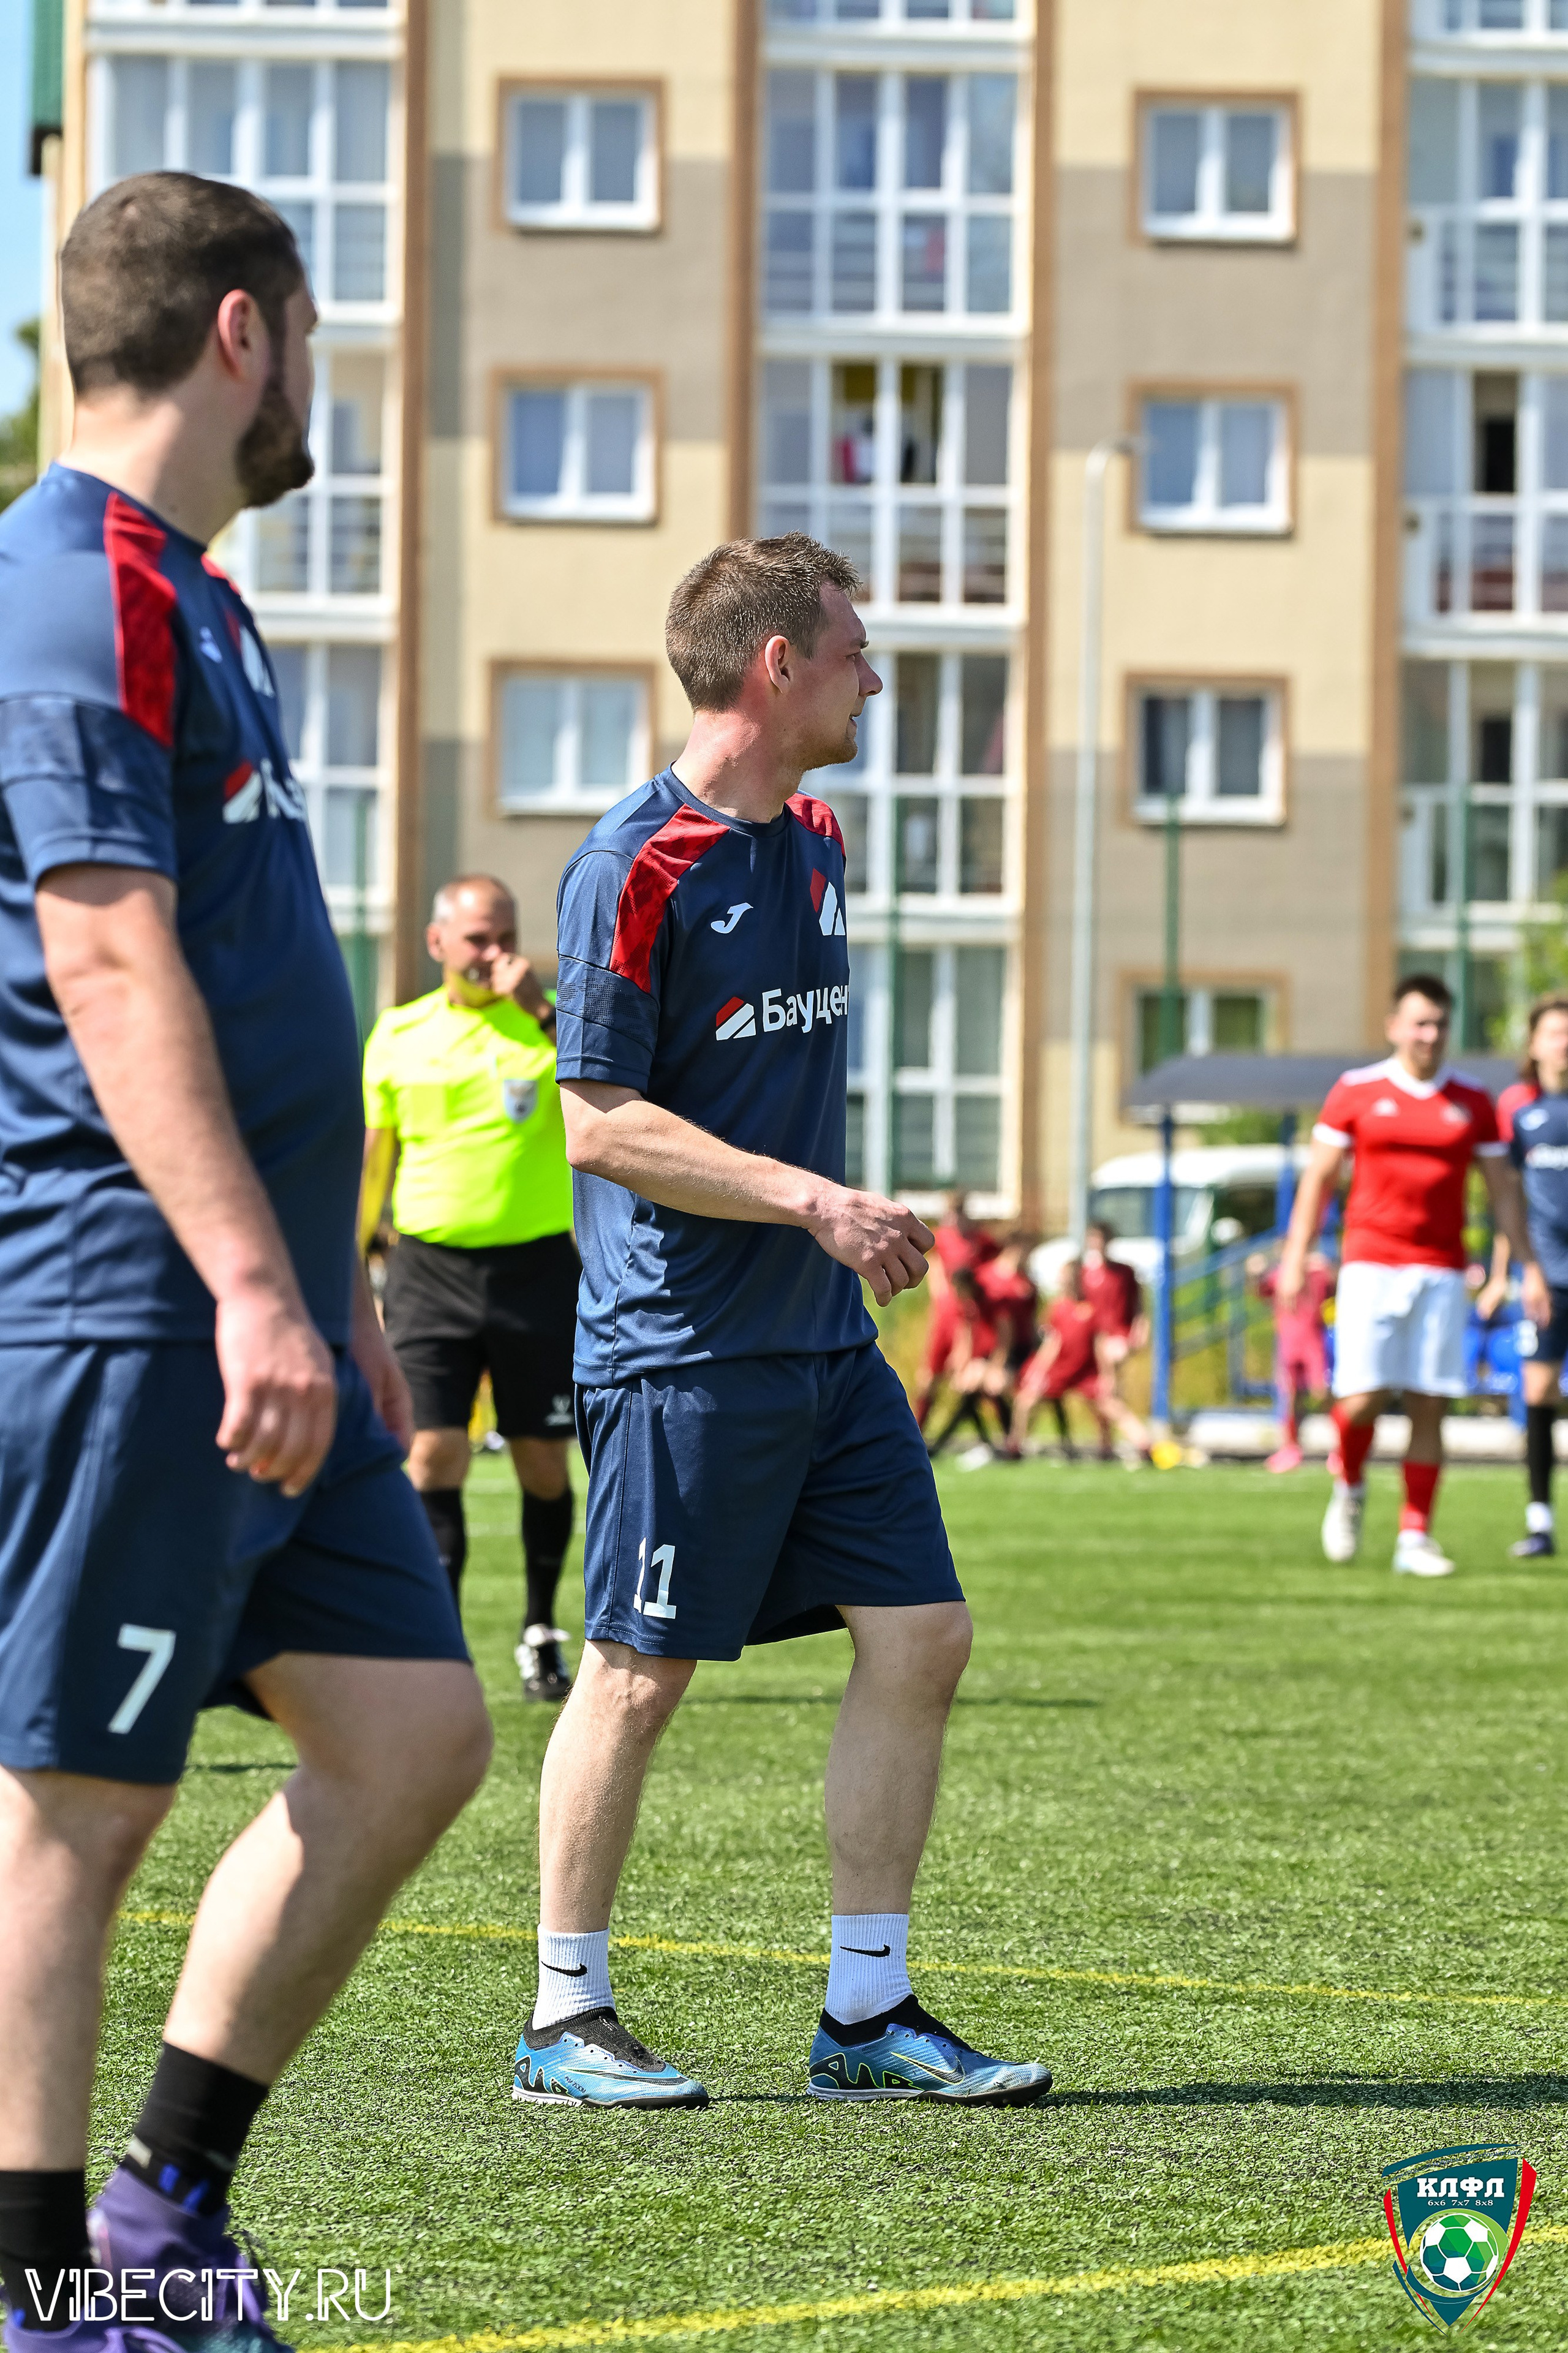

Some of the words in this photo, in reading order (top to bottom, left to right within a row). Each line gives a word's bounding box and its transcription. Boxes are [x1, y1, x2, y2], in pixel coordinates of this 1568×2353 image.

[762, 984, 850, 1033] Бауцен
[633, 1537, 677, 1619] 11
[107, 1623, 176, 1734] 7
